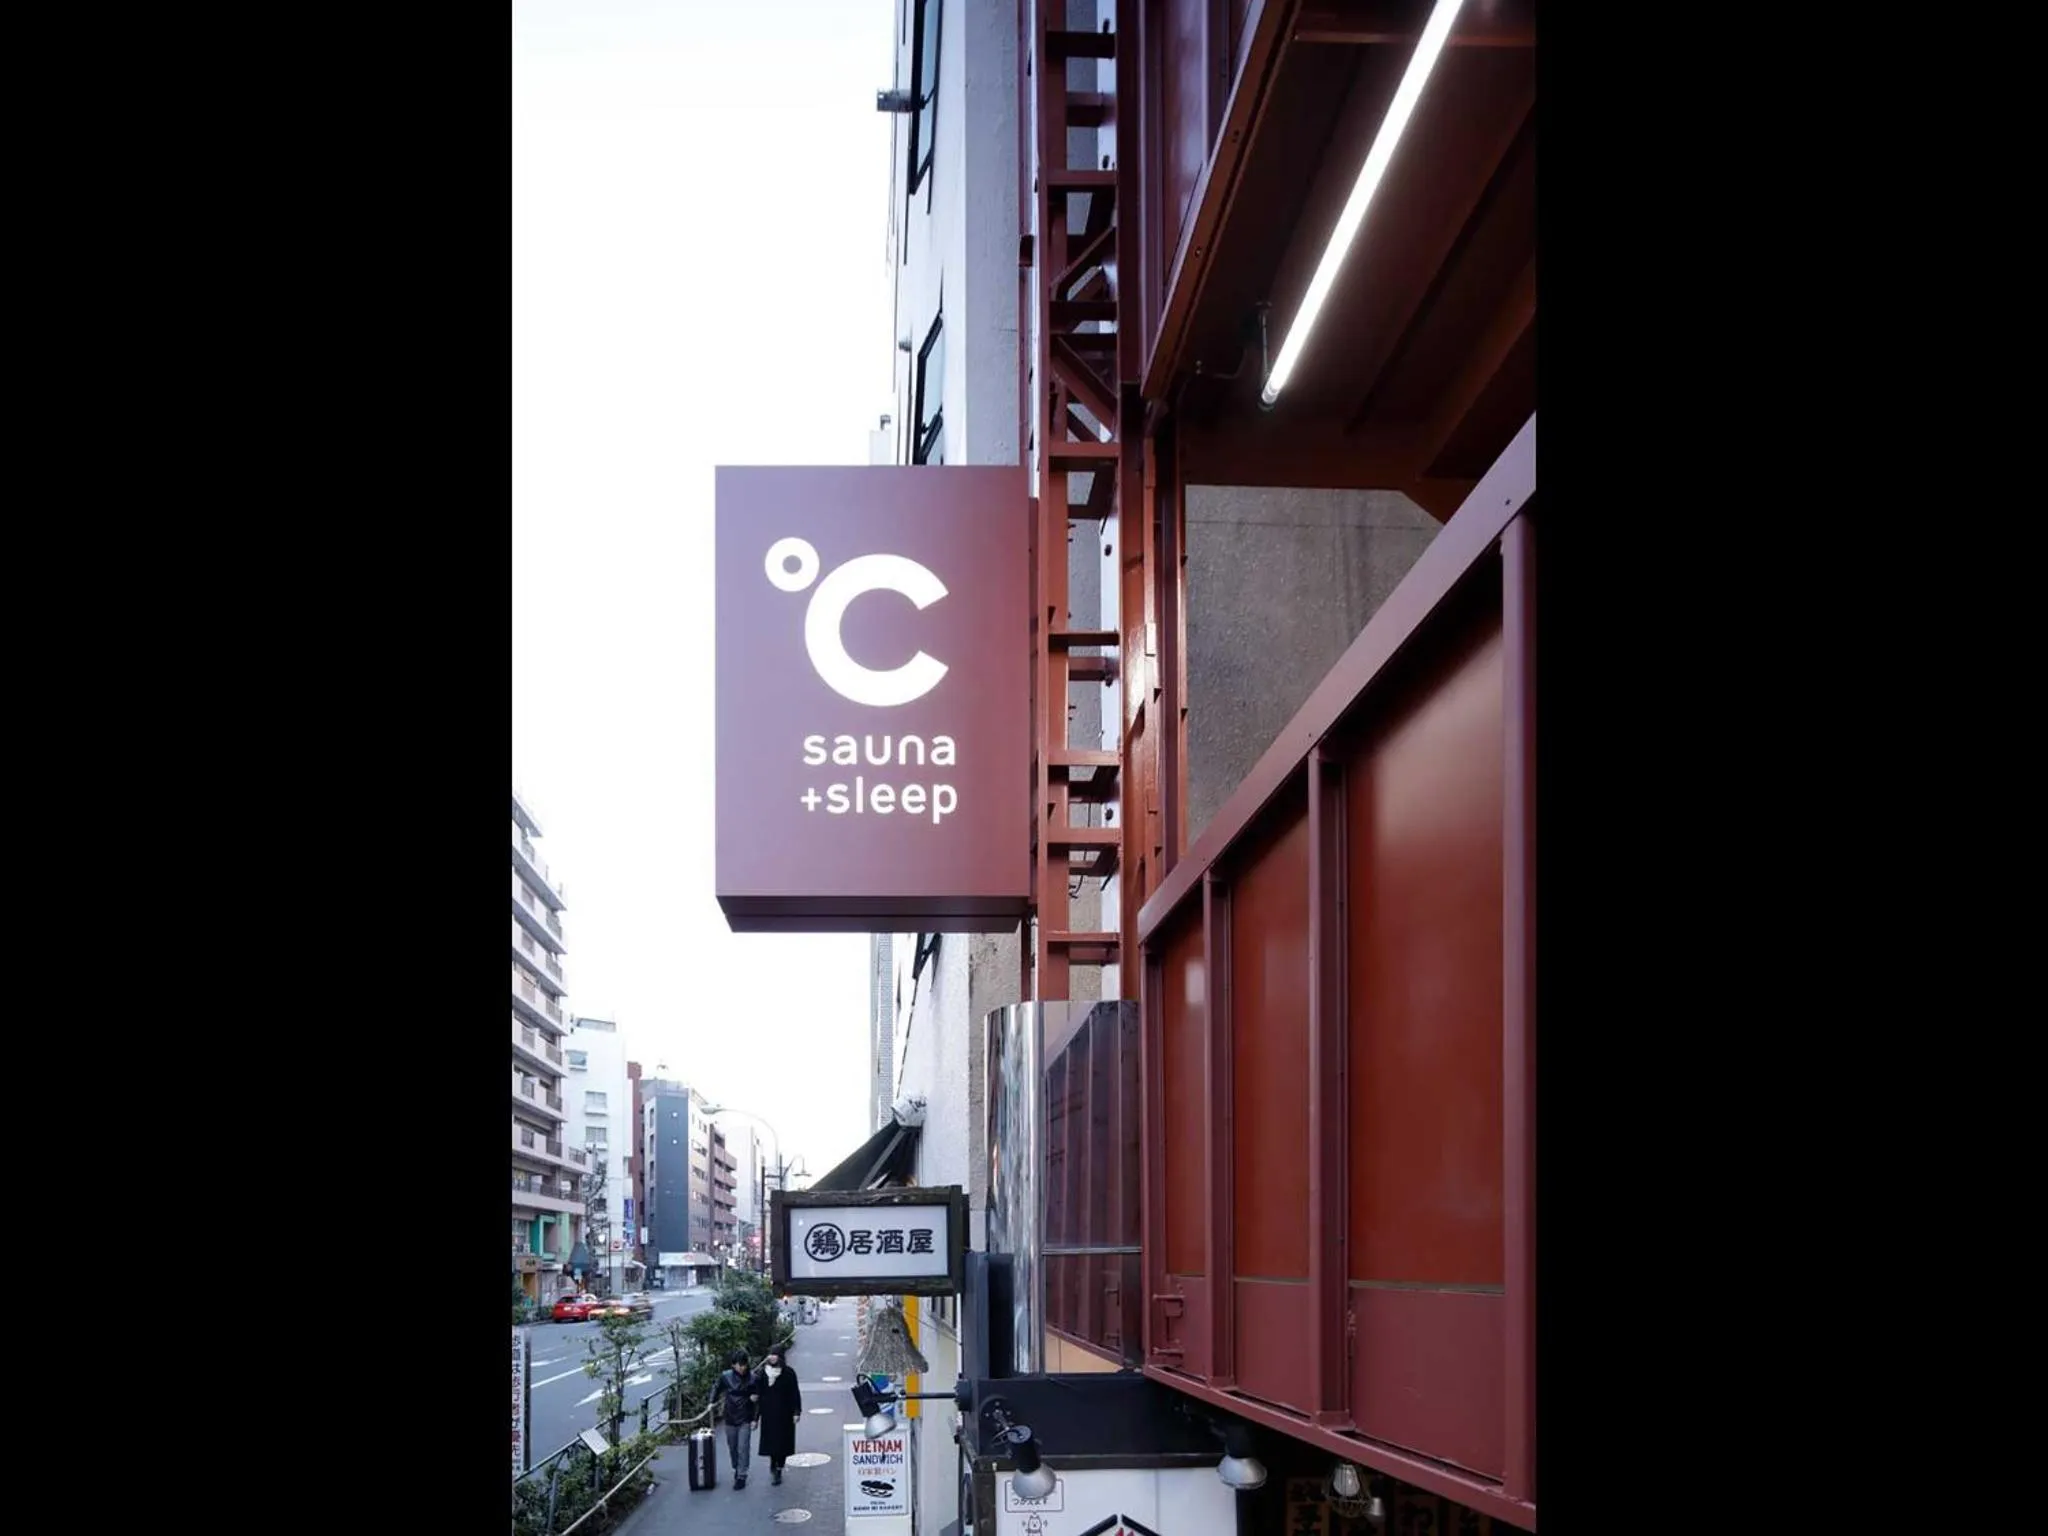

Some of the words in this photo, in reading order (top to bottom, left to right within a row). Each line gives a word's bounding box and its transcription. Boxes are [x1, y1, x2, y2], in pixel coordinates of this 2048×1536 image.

[803, 735, 956, 765] sauna
[801, 776, 957, 824] +sleep
[853, 1440, 902, 1453] VIETNAM
[853, 1454, 903, 1465] SANDWICH
